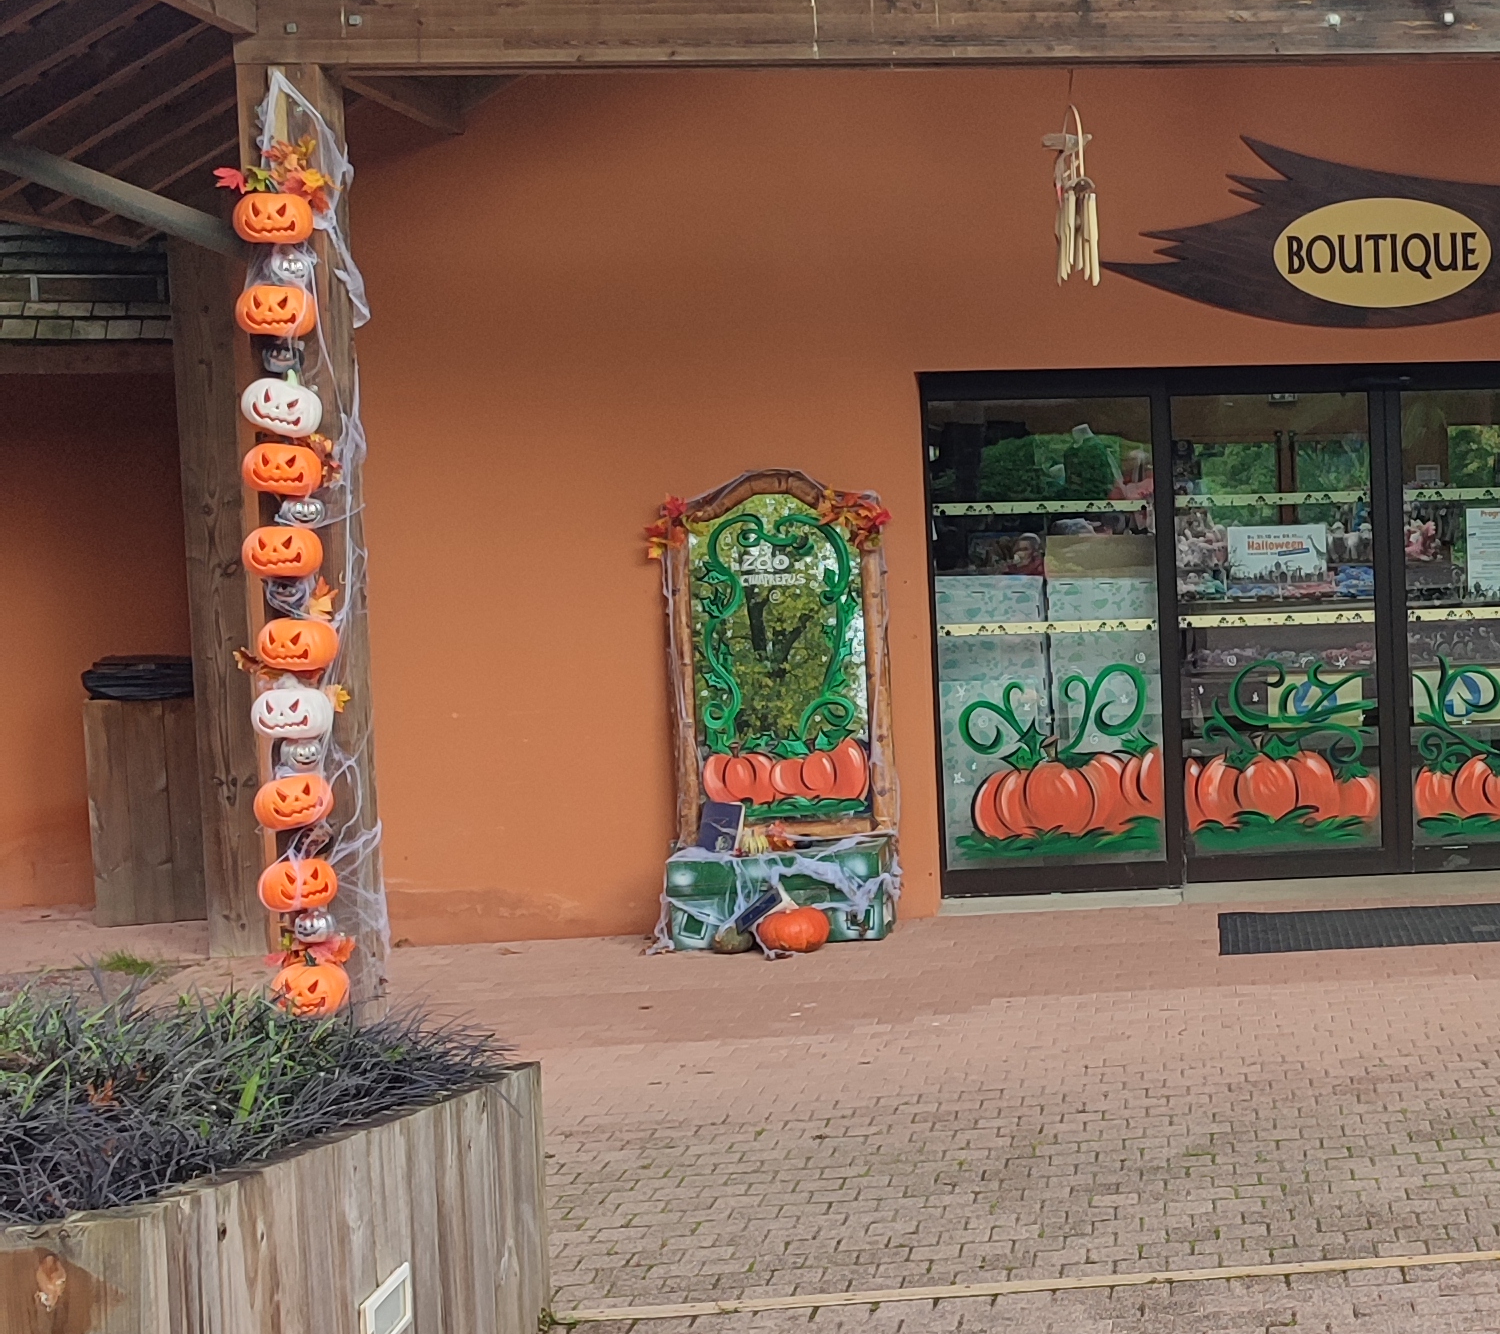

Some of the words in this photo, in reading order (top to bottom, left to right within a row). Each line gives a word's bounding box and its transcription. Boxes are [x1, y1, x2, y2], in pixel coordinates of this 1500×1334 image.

[1286, 232, 1480, 279] BOUTIQUE
[1247, 540, 1304, 550] Halloween
[741, 555, 790, 570] ZOO
